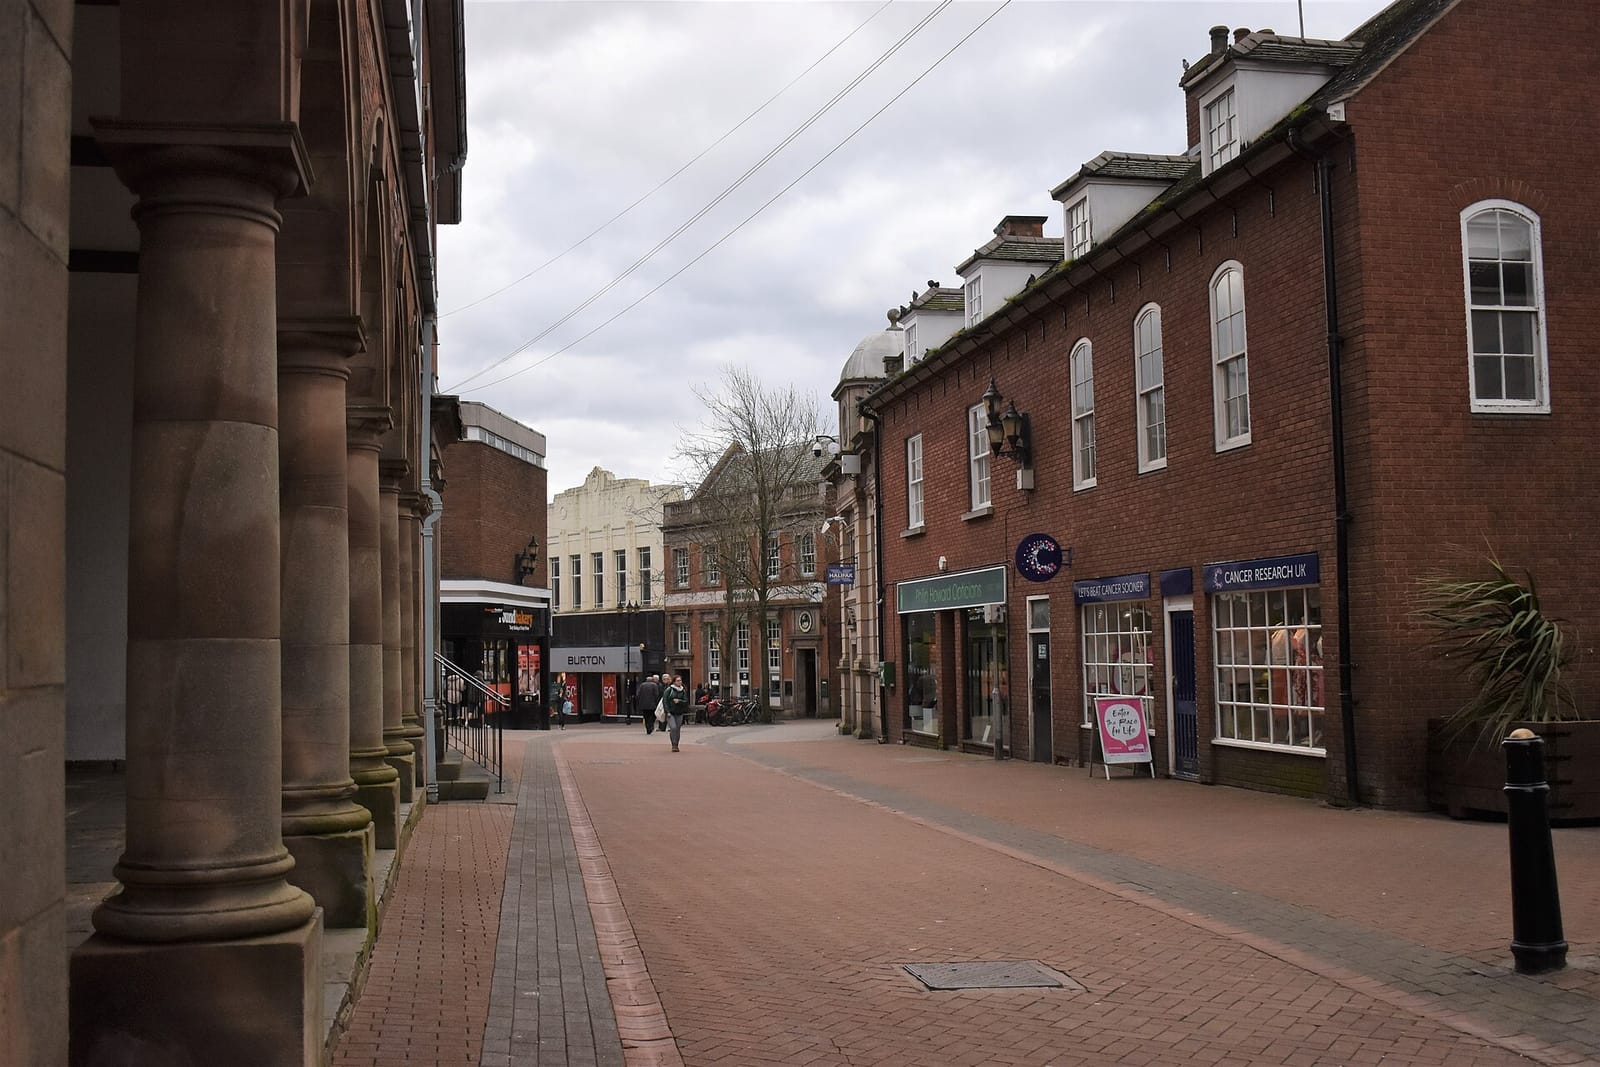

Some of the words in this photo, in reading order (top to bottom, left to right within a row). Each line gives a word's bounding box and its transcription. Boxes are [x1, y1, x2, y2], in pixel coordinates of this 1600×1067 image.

[1224, 569, 1253, 584] CANCER
[1254, 564, 1294, 581] RESEARCH
[1294, 563, 1306, 578] UK
[1090, 585, 1101, 597] BEAT
[1101, 583, 1121, 596] CANCER
[1121, 581, 1144, 594] SOONER
[567, 655, 606, 665] BURTON
[1112, 708, 1130, 717] Enter
